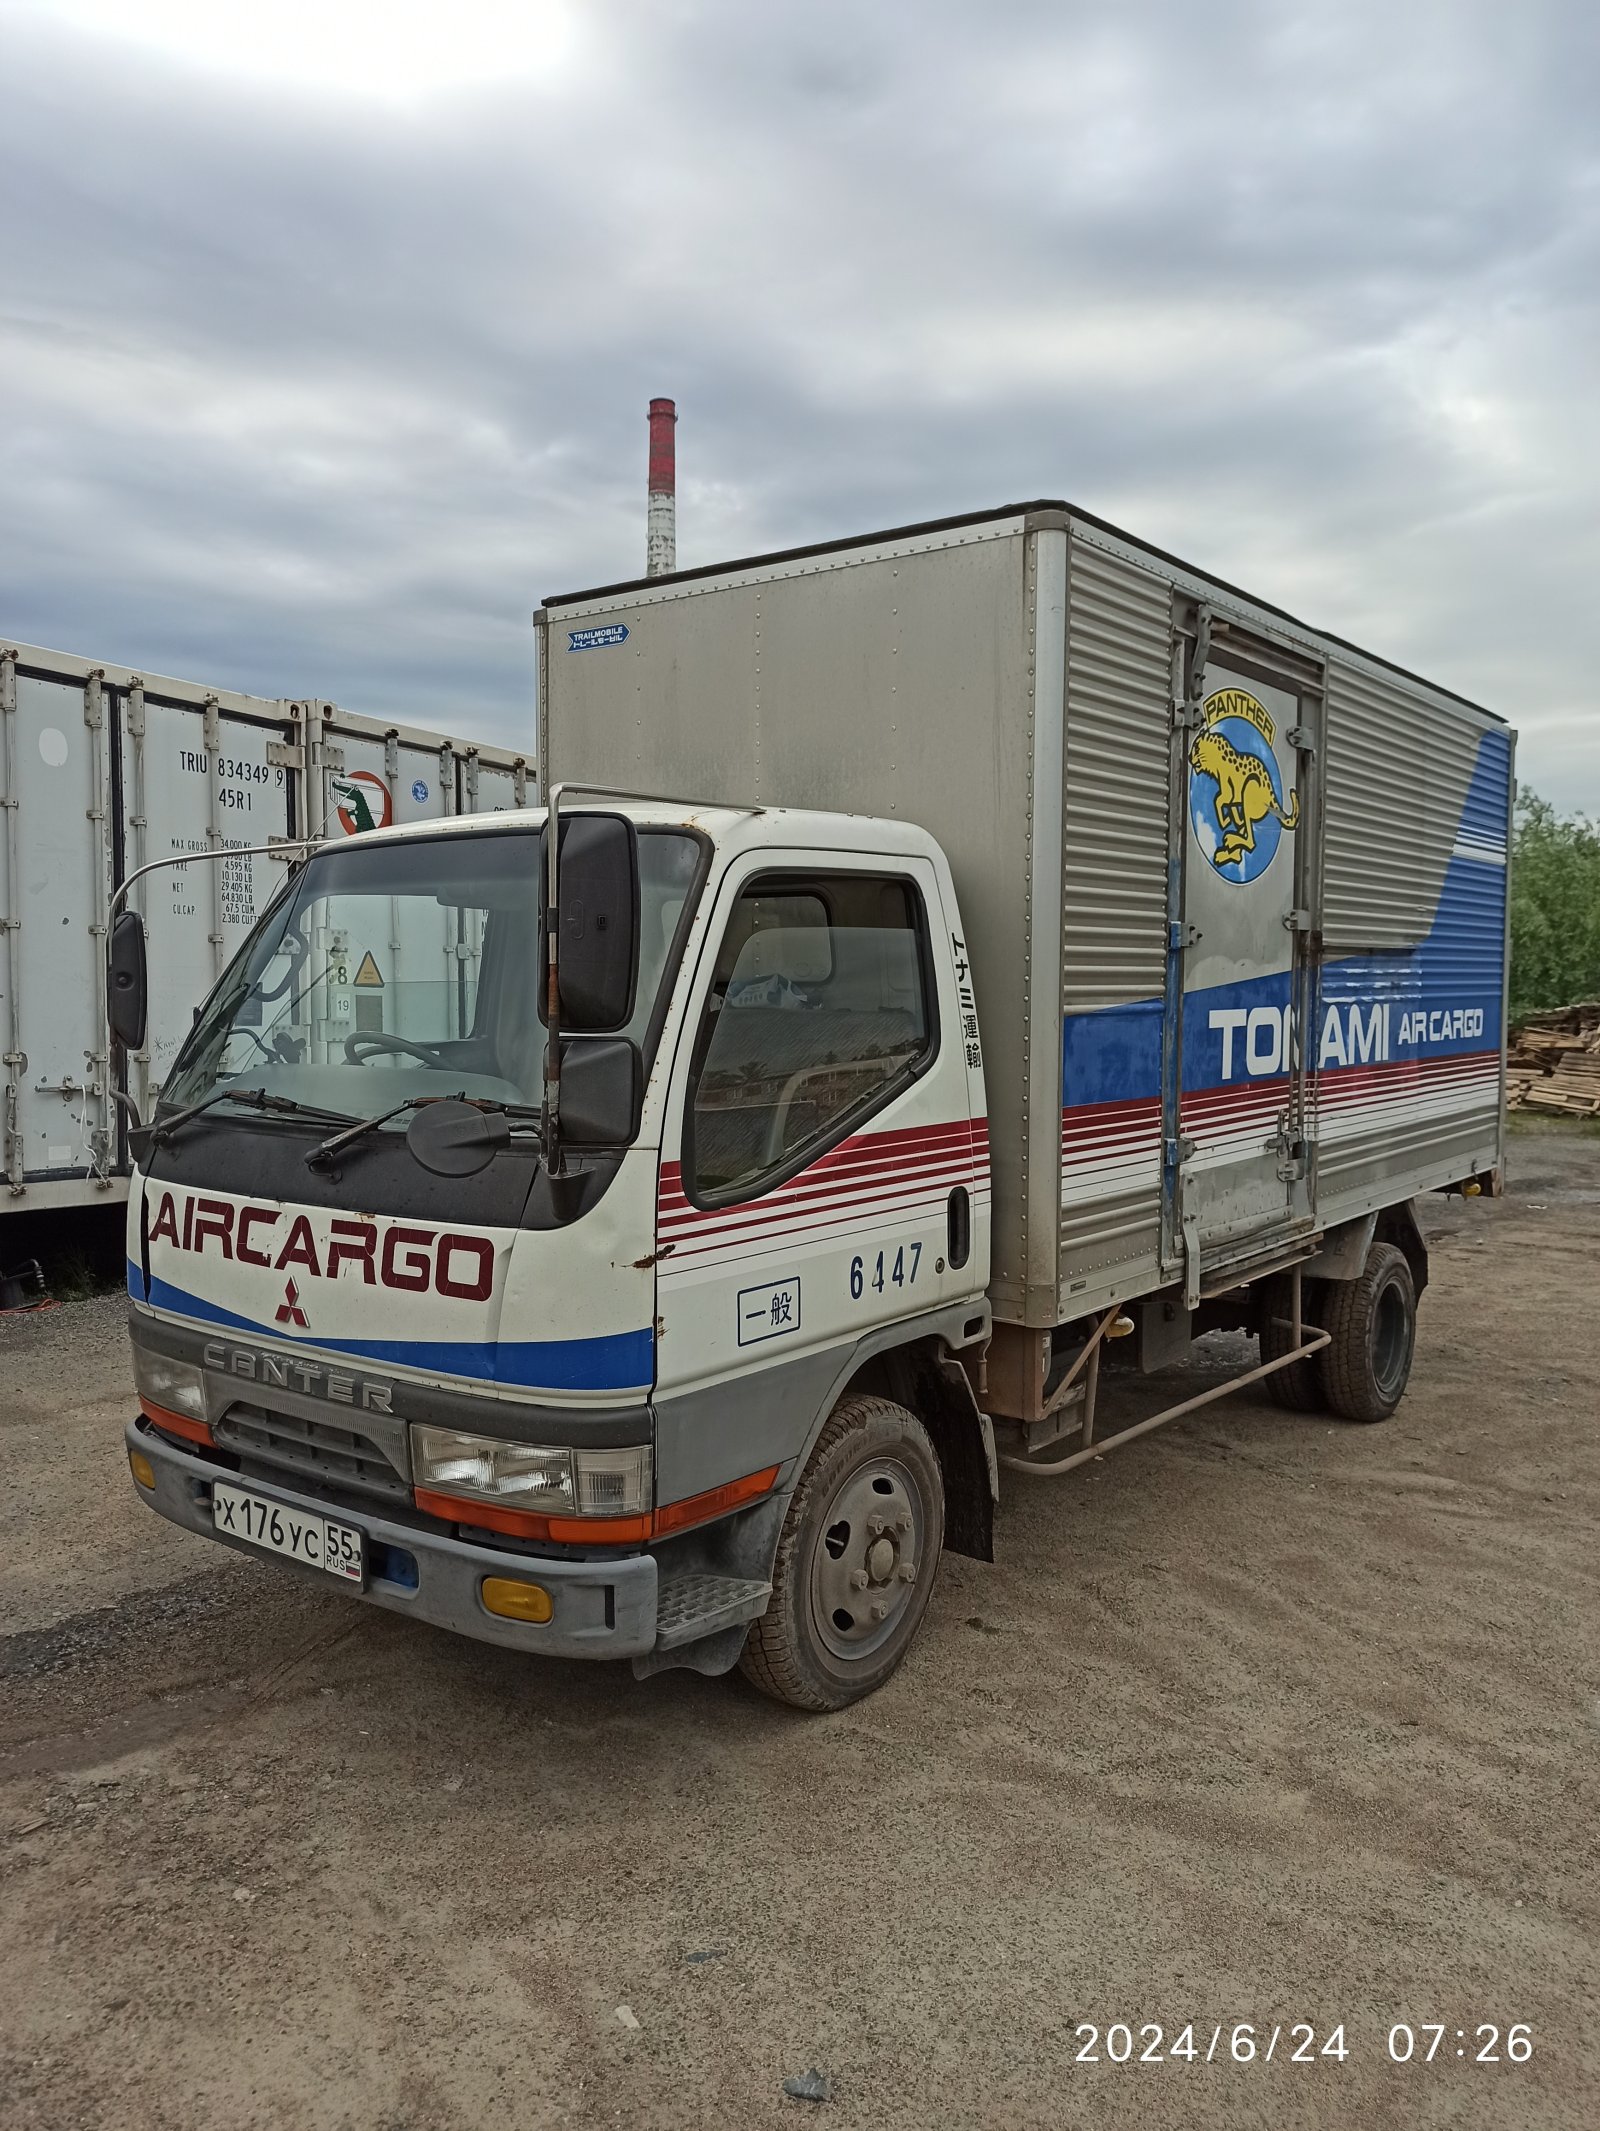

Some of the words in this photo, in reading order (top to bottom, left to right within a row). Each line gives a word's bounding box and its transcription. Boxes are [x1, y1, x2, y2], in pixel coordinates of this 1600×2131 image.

[574, 626, 623, 641] TRAILMOBILE
[1206, 693, 1273, 742] PANTHER
[180, 751, 207, 773] TRIU
[218, 758, 268, 783] 834349
[276, 770, 283, 786] 9
[219, 788, 251, 811] 45R1
[171, 839, 184, 849] MAX
[188, 840, 208, 852] GROSS
[225, 861, 242, 871] 4.595
[244, 863, 252, 873] KG
[244, 874, 252, 883] LB
[172, 882, 184, 892] NET
[221, 881, 243, 892] 29.405
[244, 884, 253, 893] KG
[225, 904, 239, 914] 67.5
[245, 895, 253, 904] LB
[338, 1000, 349, 1011] 19
[951, 932, 981, 1069] トナミ運輸
[1429, 1008, 1484, 1041] CARGO
[149, 1191, 495, 1302] AIRCARGO
[850, 1242, 922, 1300] 6447
[746, 1292, 792, 1326] 一般
[203, 1343, 394, 1414] CANTER
[327, 1525, 353, 1561] 55
[326, 1553, 345, 1571] RUS
